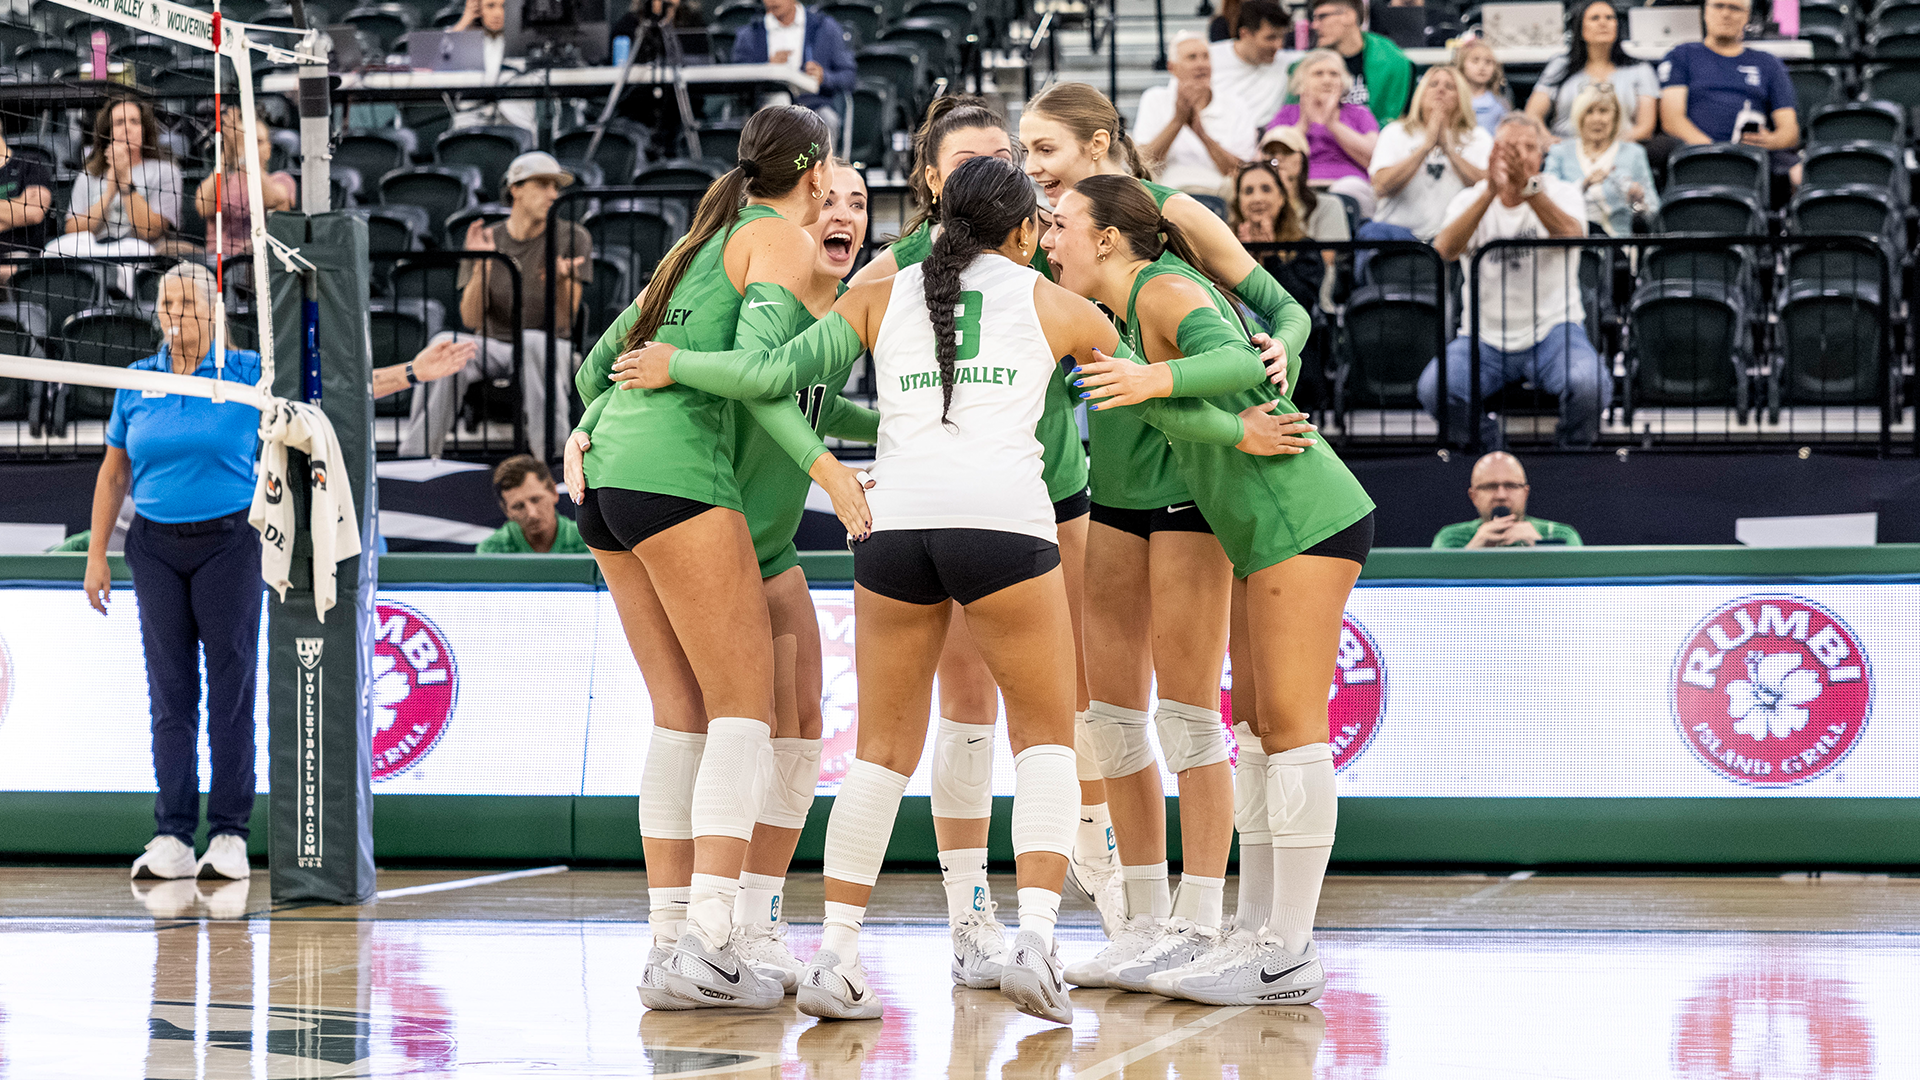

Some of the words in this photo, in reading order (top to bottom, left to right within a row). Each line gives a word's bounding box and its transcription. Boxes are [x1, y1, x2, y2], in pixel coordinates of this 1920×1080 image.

[167, 10, 214, 40] WOLVERINE
[899, 370, 942, 392] UTAH
[1682, 604, 1861, 689] RUMBI
[1693, 722, 1773, 774] ISLAND
[1780, 722, 1848, 775] GRILL
